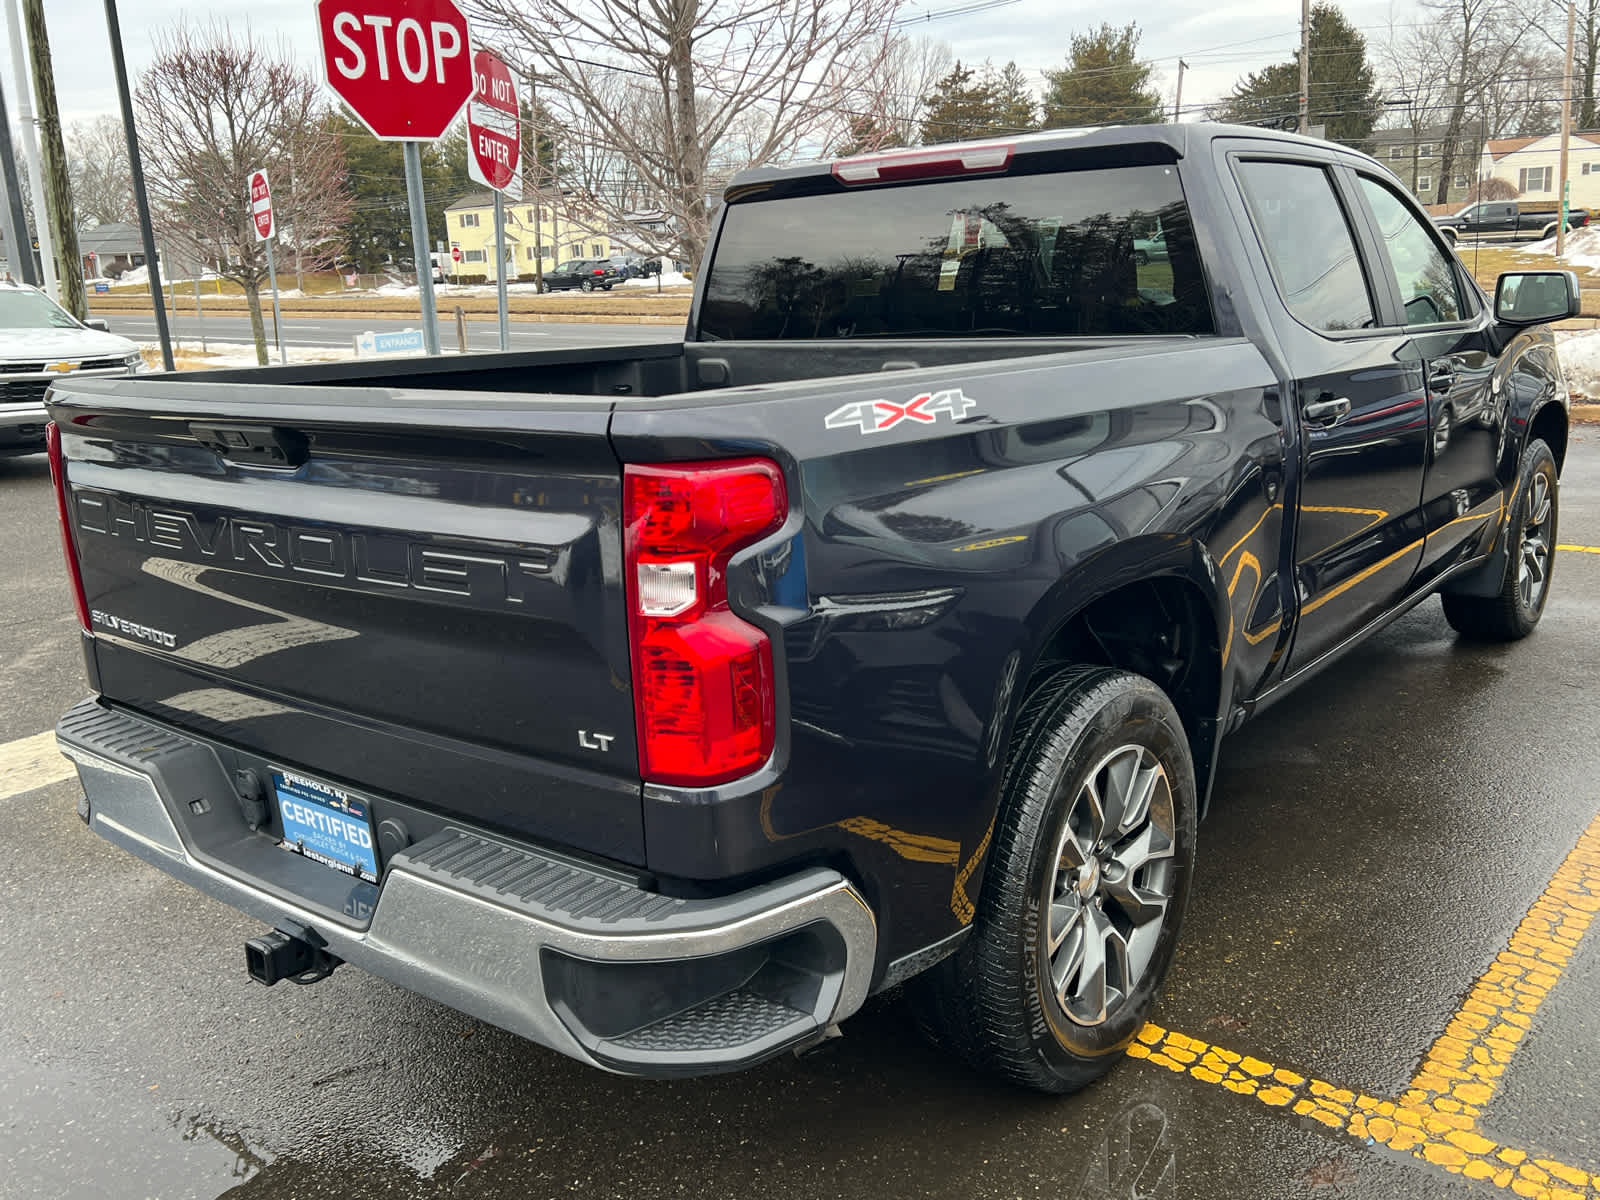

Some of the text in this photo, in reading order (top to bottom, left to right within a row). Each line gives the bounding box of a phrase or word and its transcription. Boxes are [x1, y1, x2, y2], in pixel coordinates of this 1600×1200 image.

[333, 11, 461, 84] STOP
[492, 79, 511, 102] NOT
[479, 135, 510, 167] ENTER
[380, 333, 418, 349] ENTRANCE
[76, 490, 553, 603] CHEVROLET
[91, 609, 177, 648] SILVERADO
[578, 730, 615, 752] LT
[281, 799, 373, 849] CERTIFIED
[1024, 895, 1049, 1041] BRIDGESTONE
